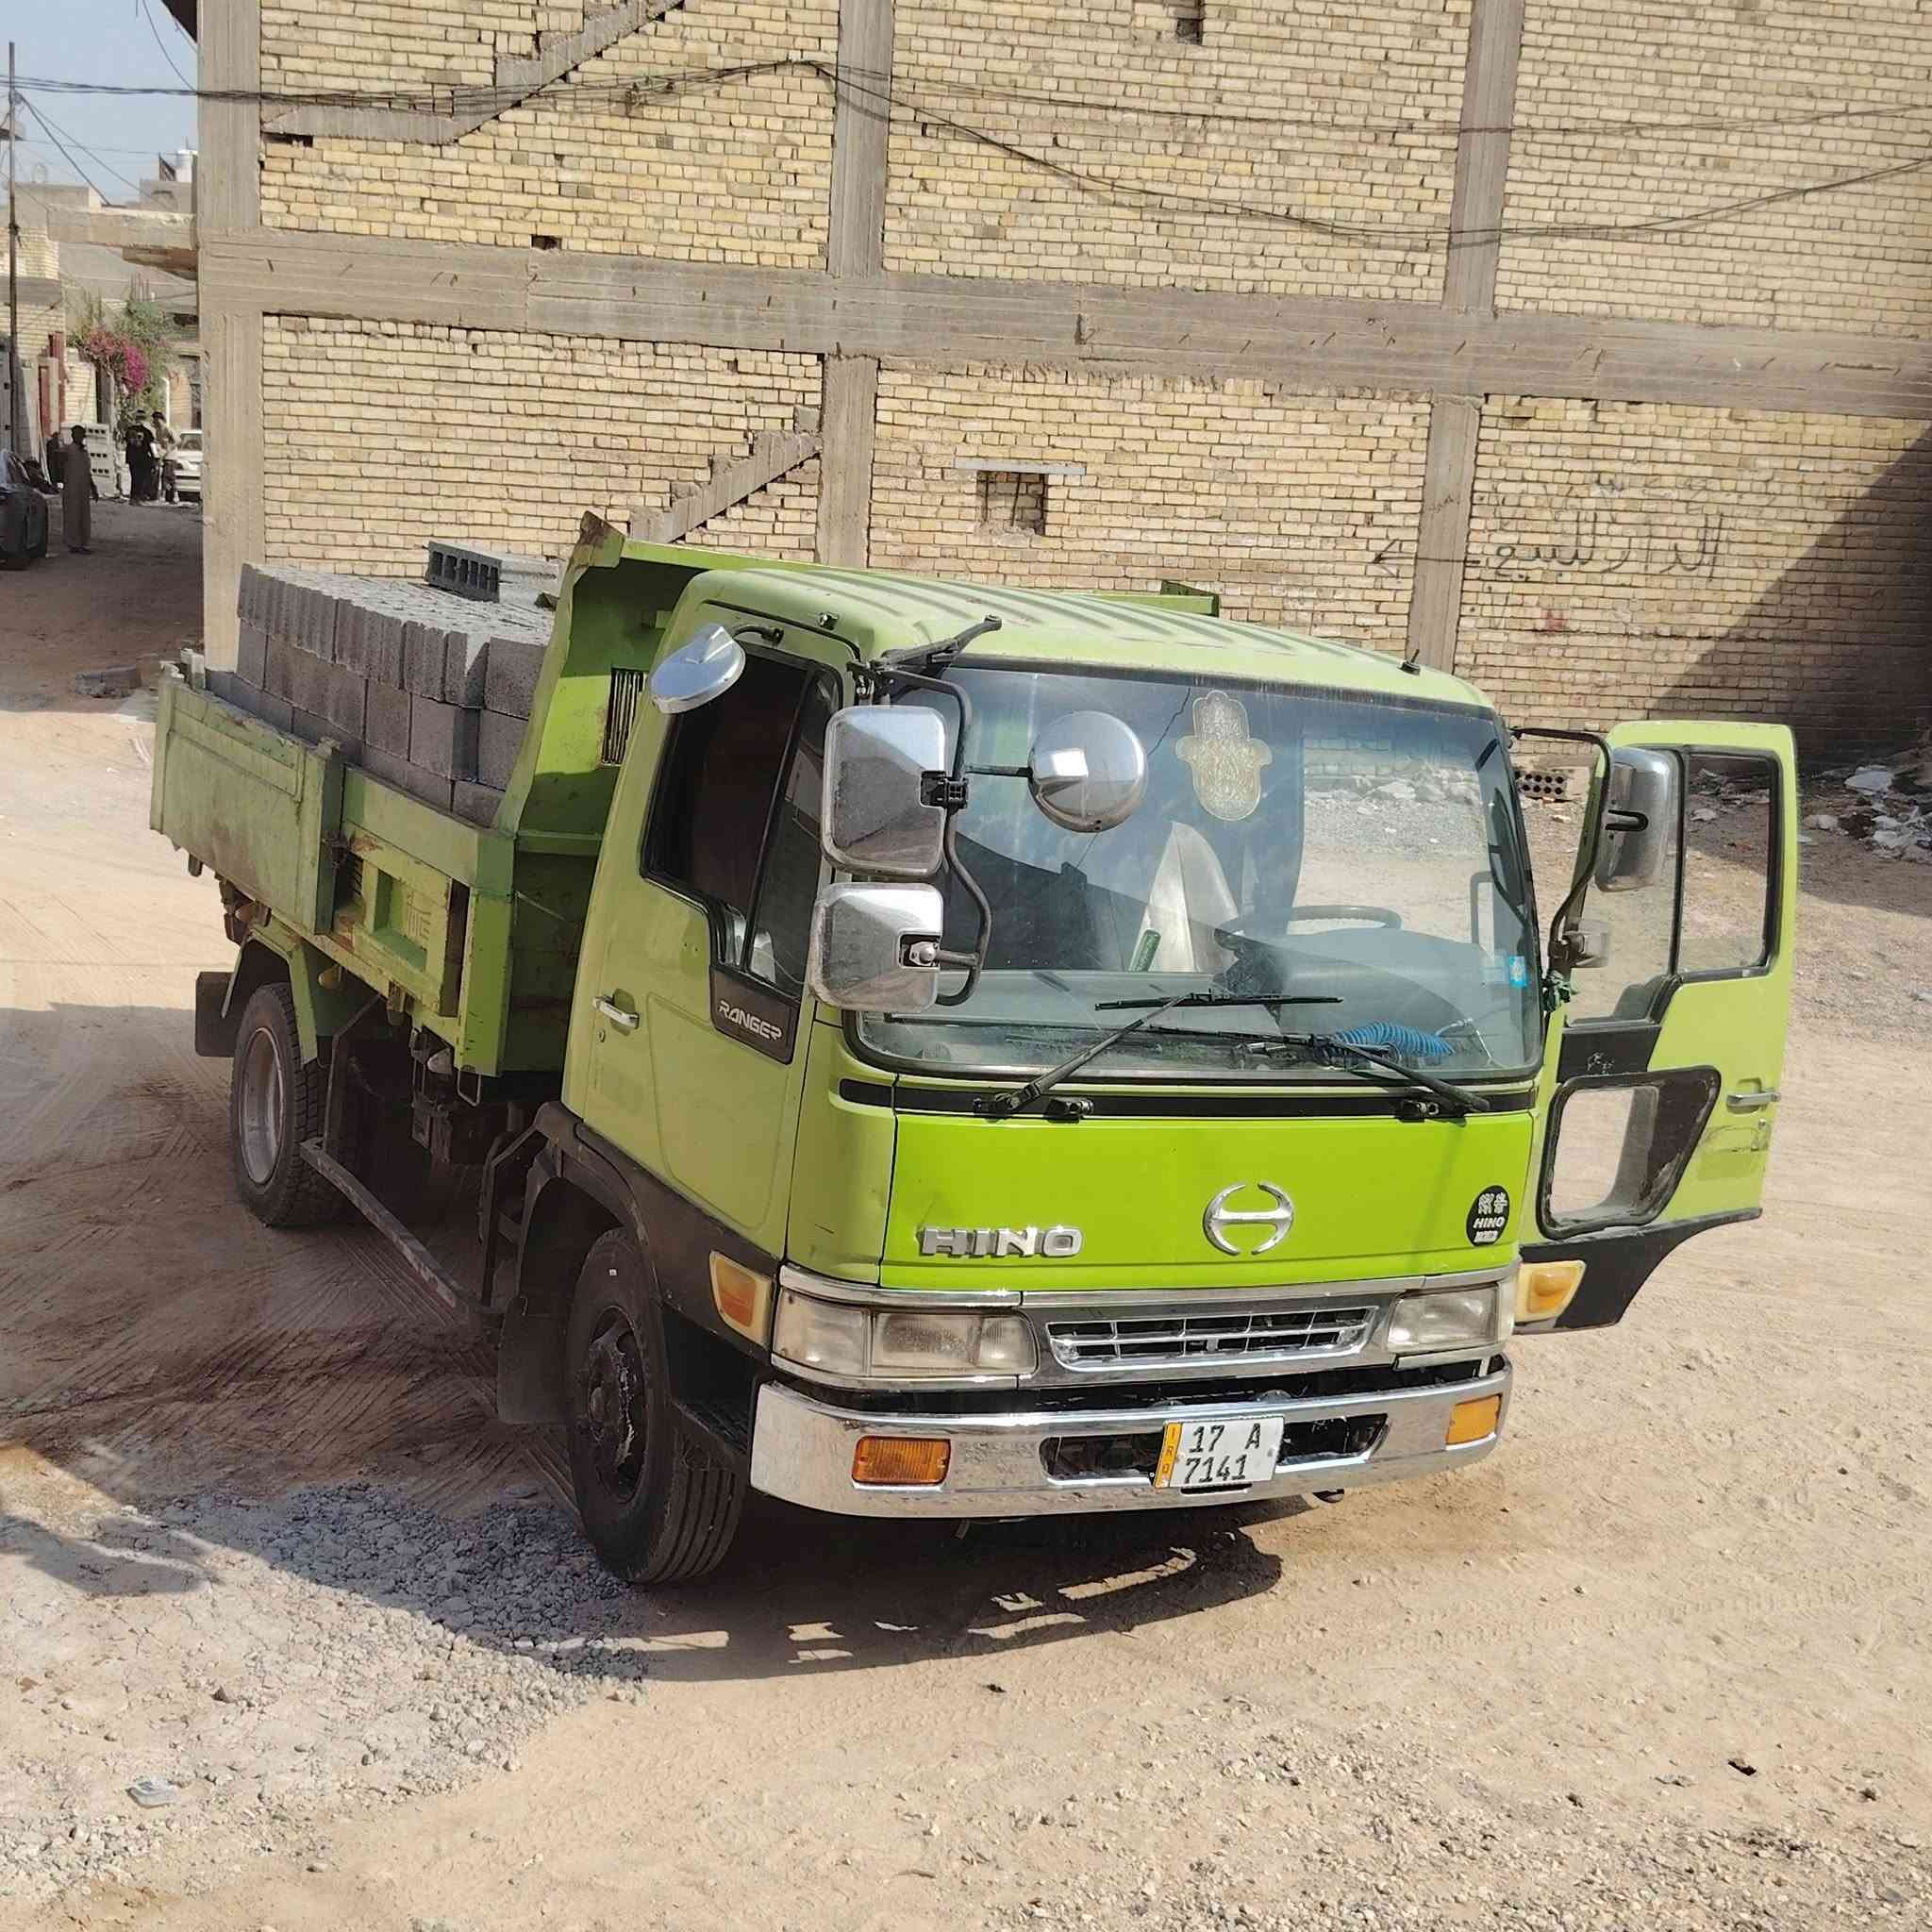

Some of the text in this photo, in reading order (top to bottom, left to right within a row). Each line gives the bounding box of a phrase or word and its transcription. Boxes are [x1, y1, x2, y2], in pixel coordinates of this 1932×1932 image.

[718, 999, 783, 1041] RANGER
[1473, 1216, 1506, 1228] HINO
[919, 1225, 1084, 1257] HINO
[1189, 1422, 1261, 1454] 17 A
[1184, 1453, 1247, 1484] 7141
